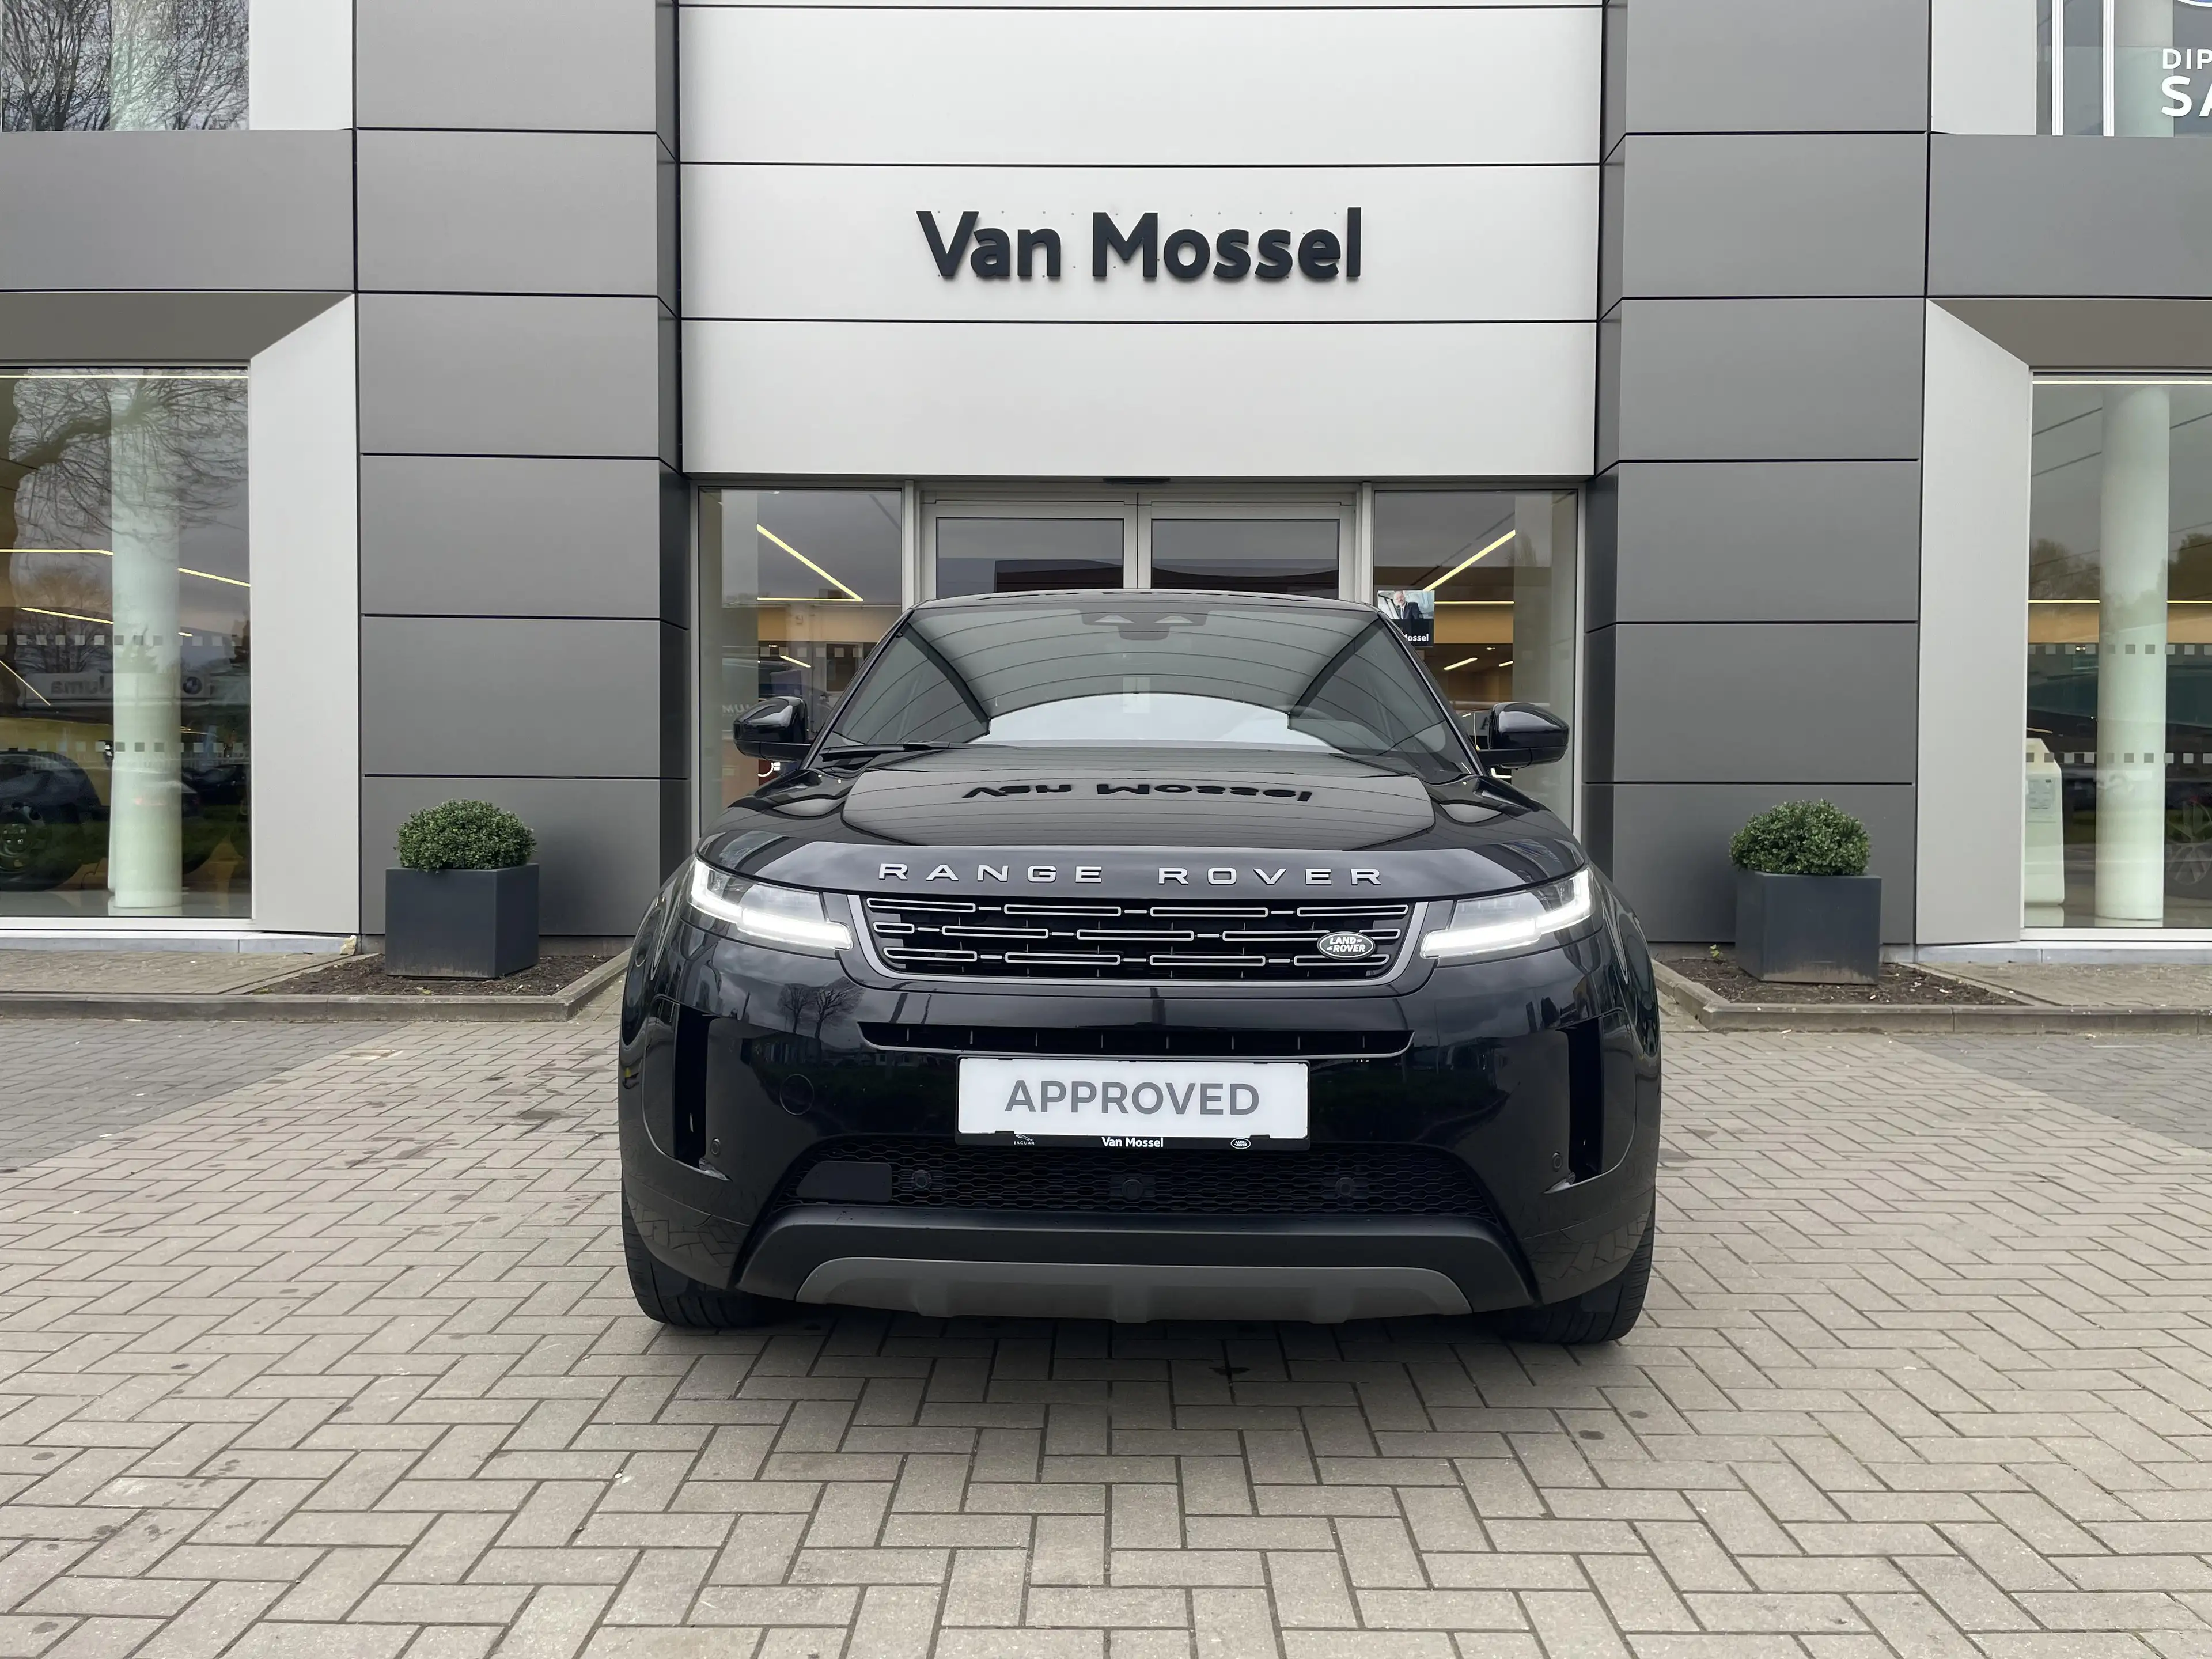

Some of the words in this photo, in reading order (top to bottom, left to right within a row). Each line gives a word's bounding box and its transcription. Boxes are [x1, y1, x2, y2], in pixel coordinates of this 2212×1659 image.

[916, 210, 1062, 279] Van
[1092, 207, 1362, 279] Mossel
[878, 863, 1103, 884] RANGE
[1158, 868, 1382, 886] ROVER
[1329, 937, 1357, 945] LAND
[1332, 944, 1366, 953] ROVER
[1004, 1080, 1260, 1116] APPROVED
[1101, 1137, 1123, 1147] Van
[1125, 1137, 1164, 1147] Mossel
